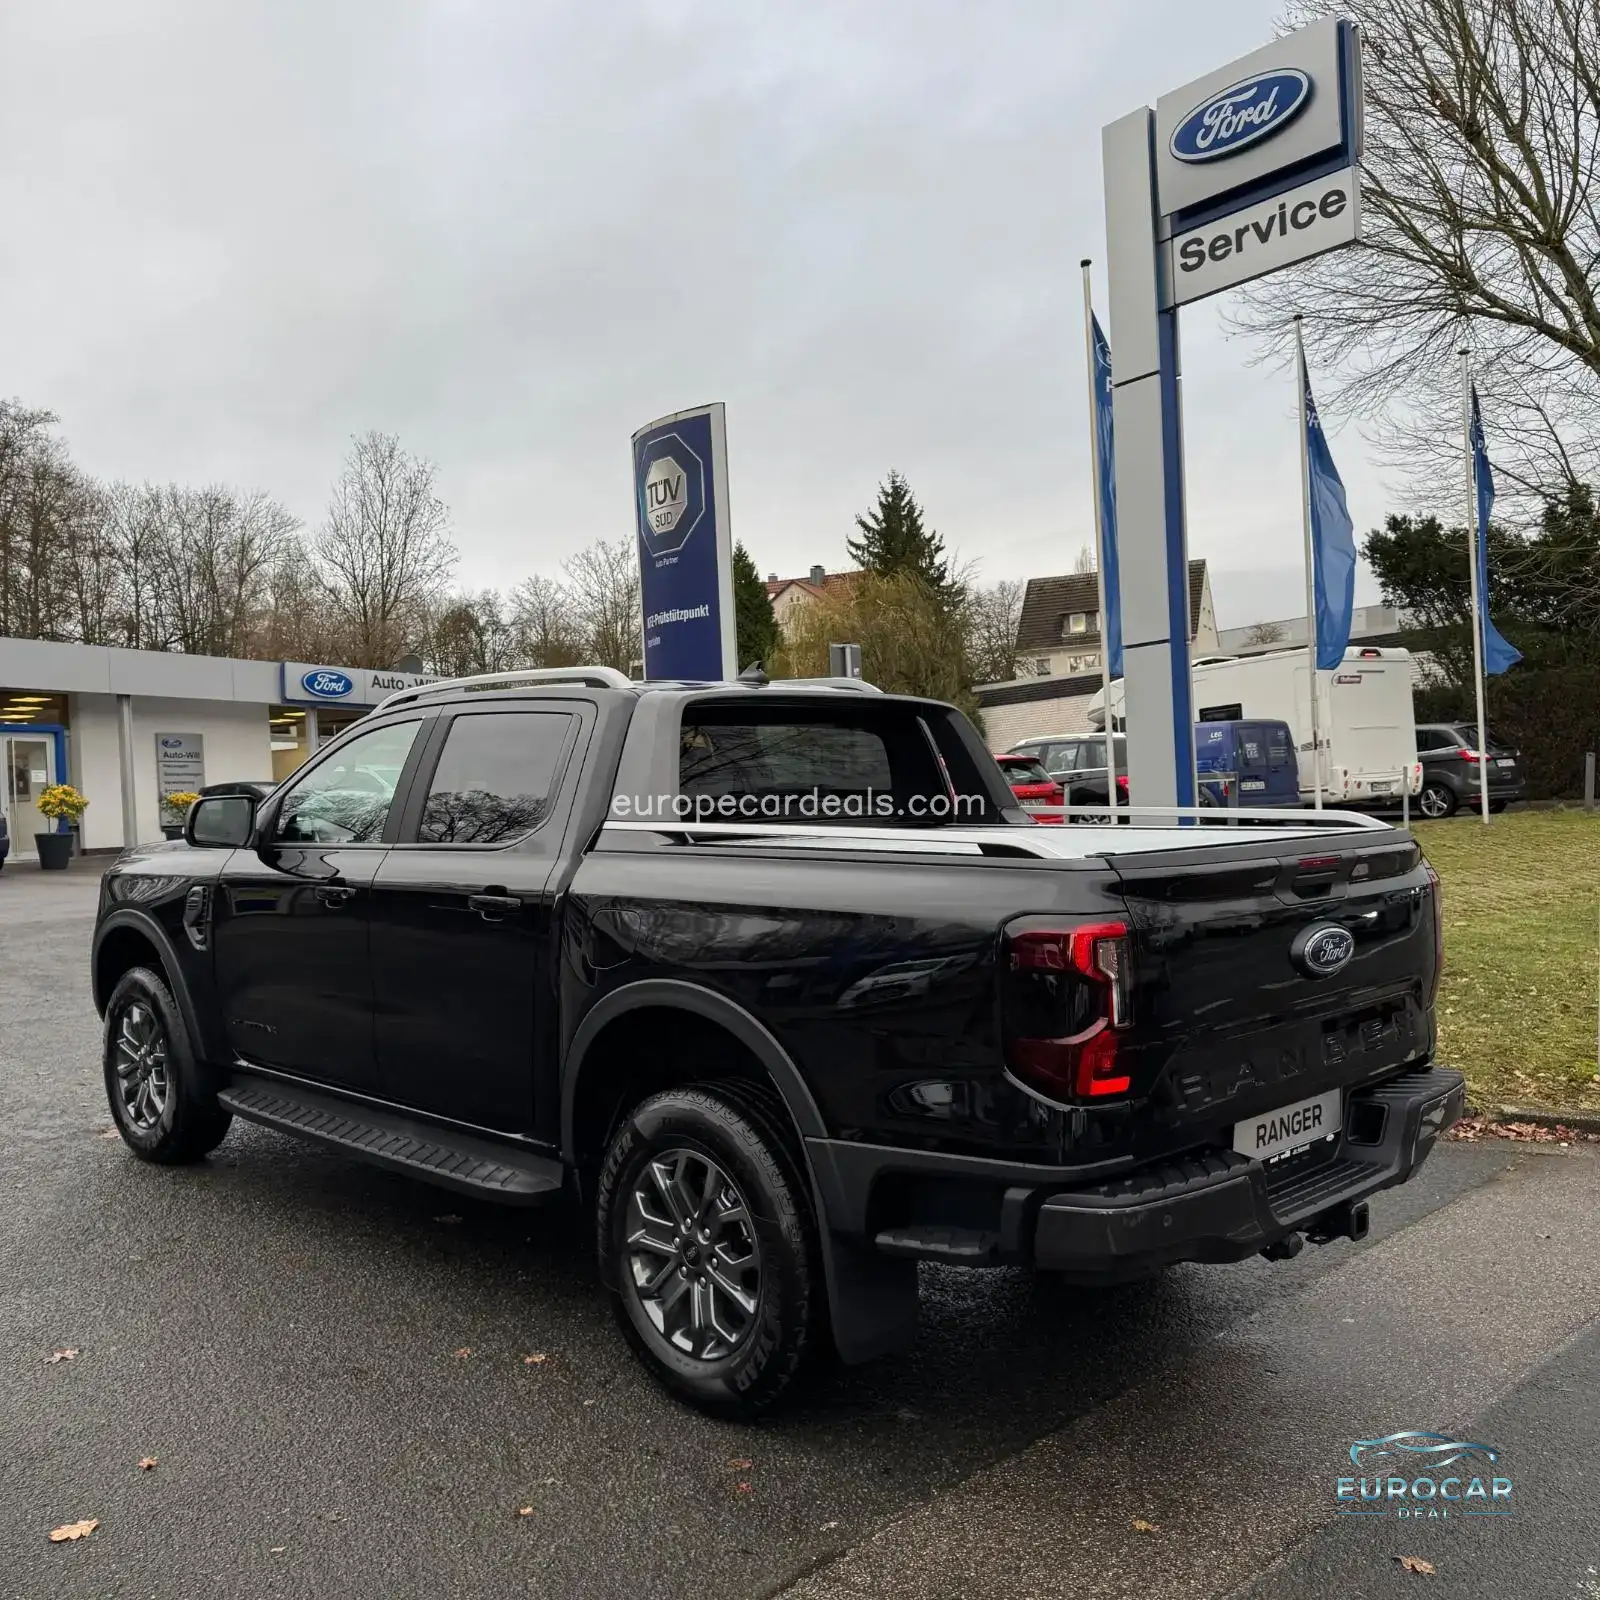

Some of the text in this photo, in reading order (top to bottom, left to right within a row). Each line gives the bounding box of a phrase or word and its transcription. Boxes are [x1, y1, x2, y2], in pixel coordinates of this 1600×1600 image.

[1196, 86, 1280, 149] Ford
[1179, 189, 1348, 273] Service
[647, 475, 681, 508] TÜV
[314, 673, 345, 692] Ford
[371, 674, 405, 690] Auto
[1320, 937, 1346, 962] Ford
[1256, 1103, 1323, 1149] RANGER
